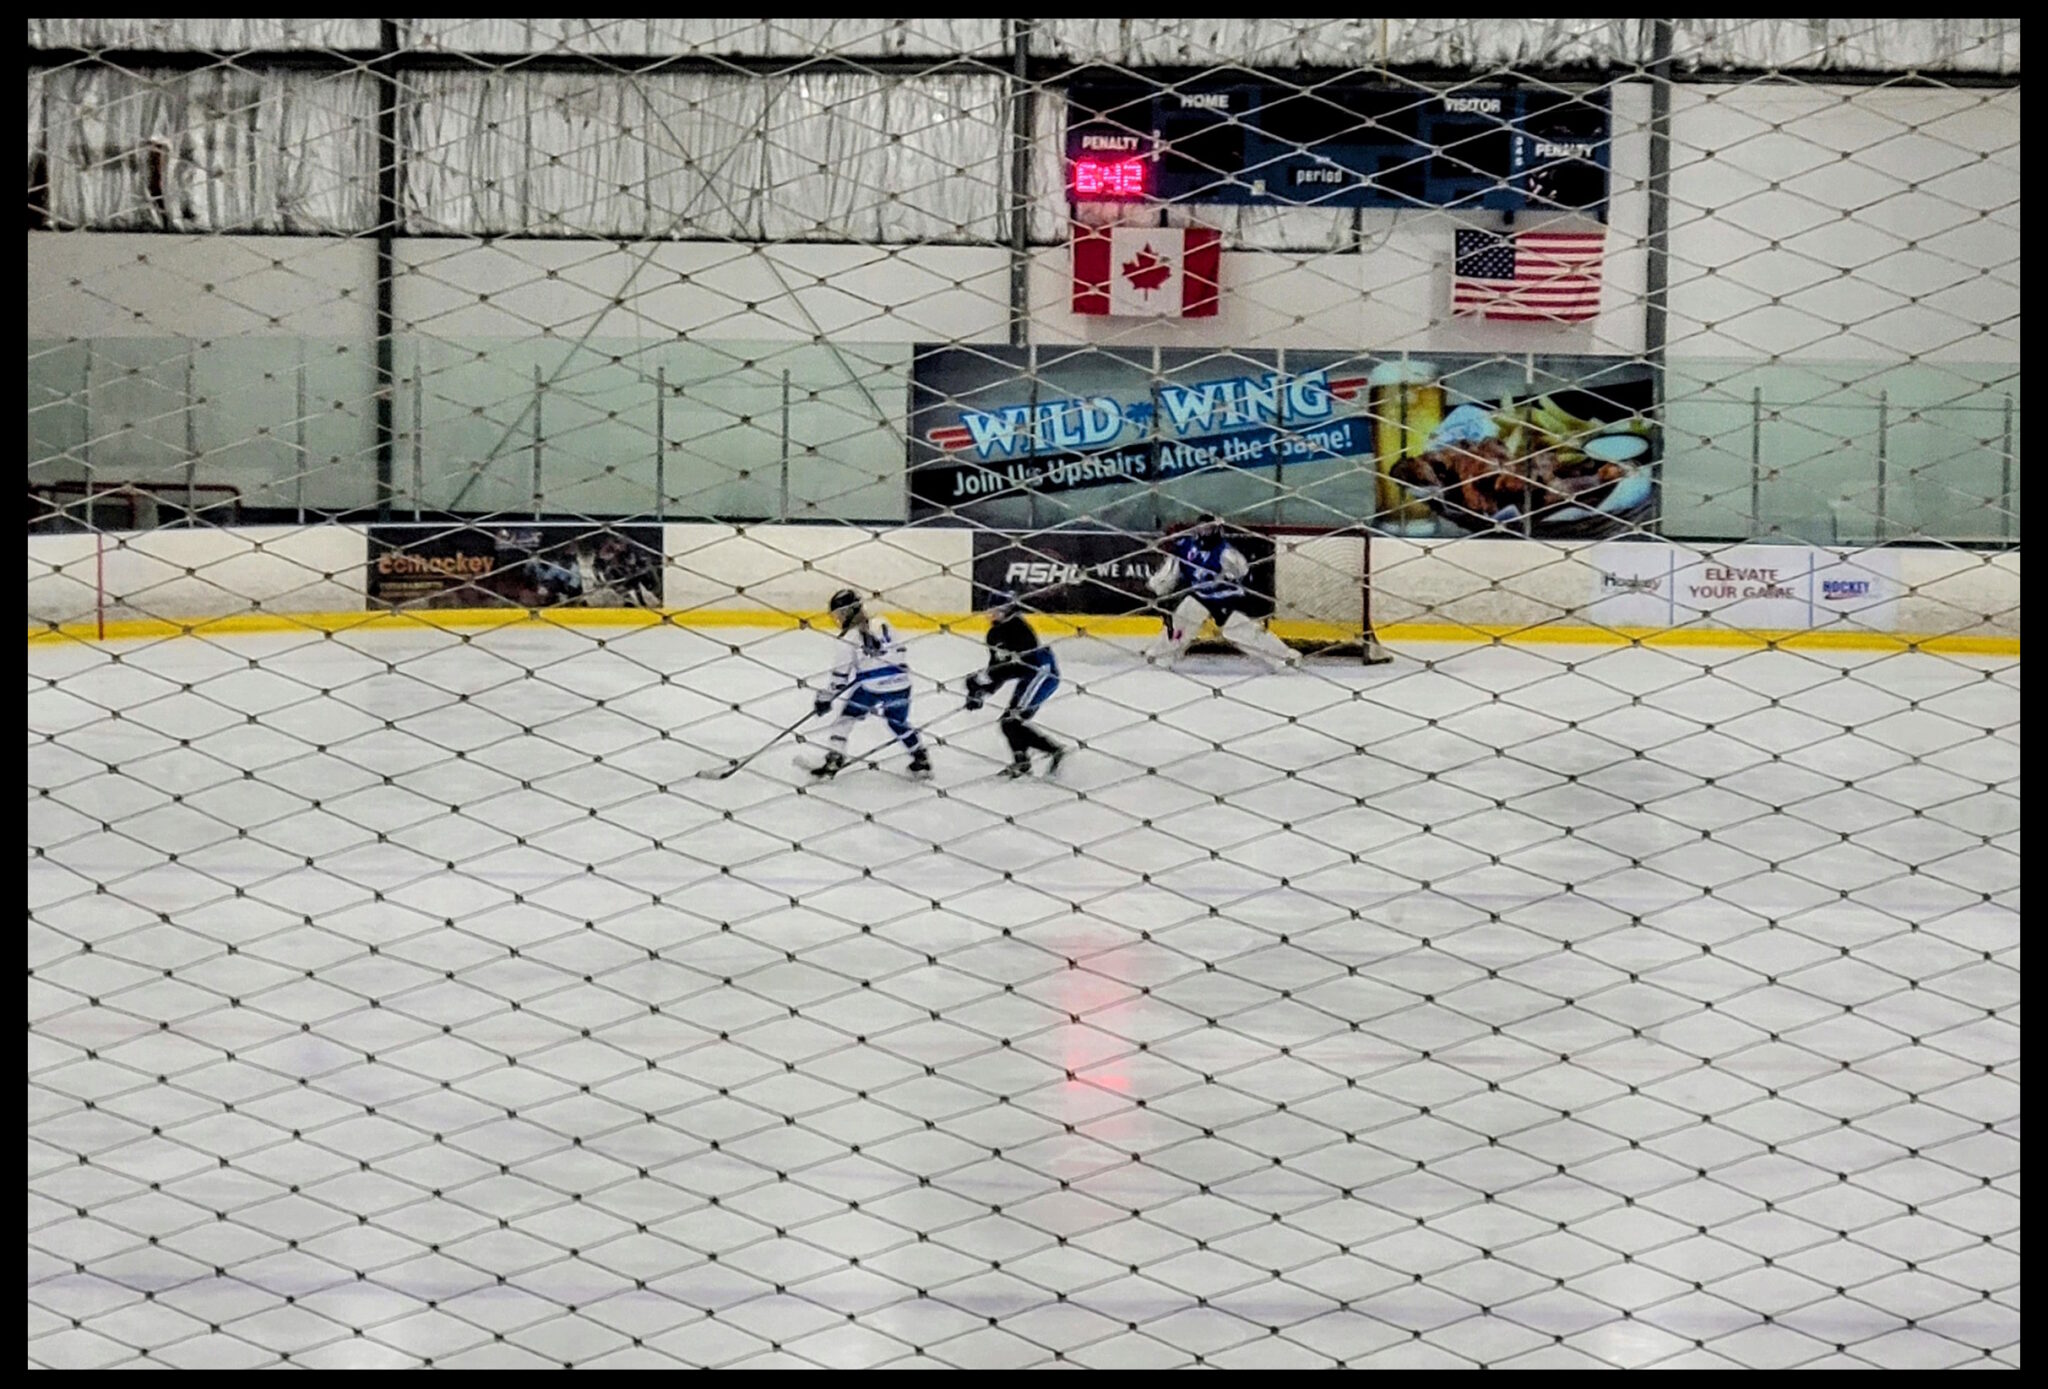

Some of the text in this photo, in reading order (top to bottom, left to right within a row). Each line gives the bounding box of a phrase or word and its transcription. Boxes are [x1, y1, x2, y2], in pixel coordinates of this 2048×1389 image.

[1180, 94, 1229, 109] HOME
[1444, 99, 1501, 112] VISITOR
[1082, 136, 1139, 150] PENALTY
[1534, 143, 1593, 157] PENALTY
[1076, 162, 1142, 192] 6:42
[1296, 169, 1342, 186] period
[959, 369, 1332, 458] WILD WING
[953, 470, 1003, 496] Join
[1047, 452, 1146, 486] Upstairs
[1159, 444, 1217, 471] After
[1223, 436, 1263, 460] the
[1097, 563, 1121, 577] WE
[1705, 568, 1779, 581] ELEVATE
[1690, 585, 1796, 599] YOUR GAME
